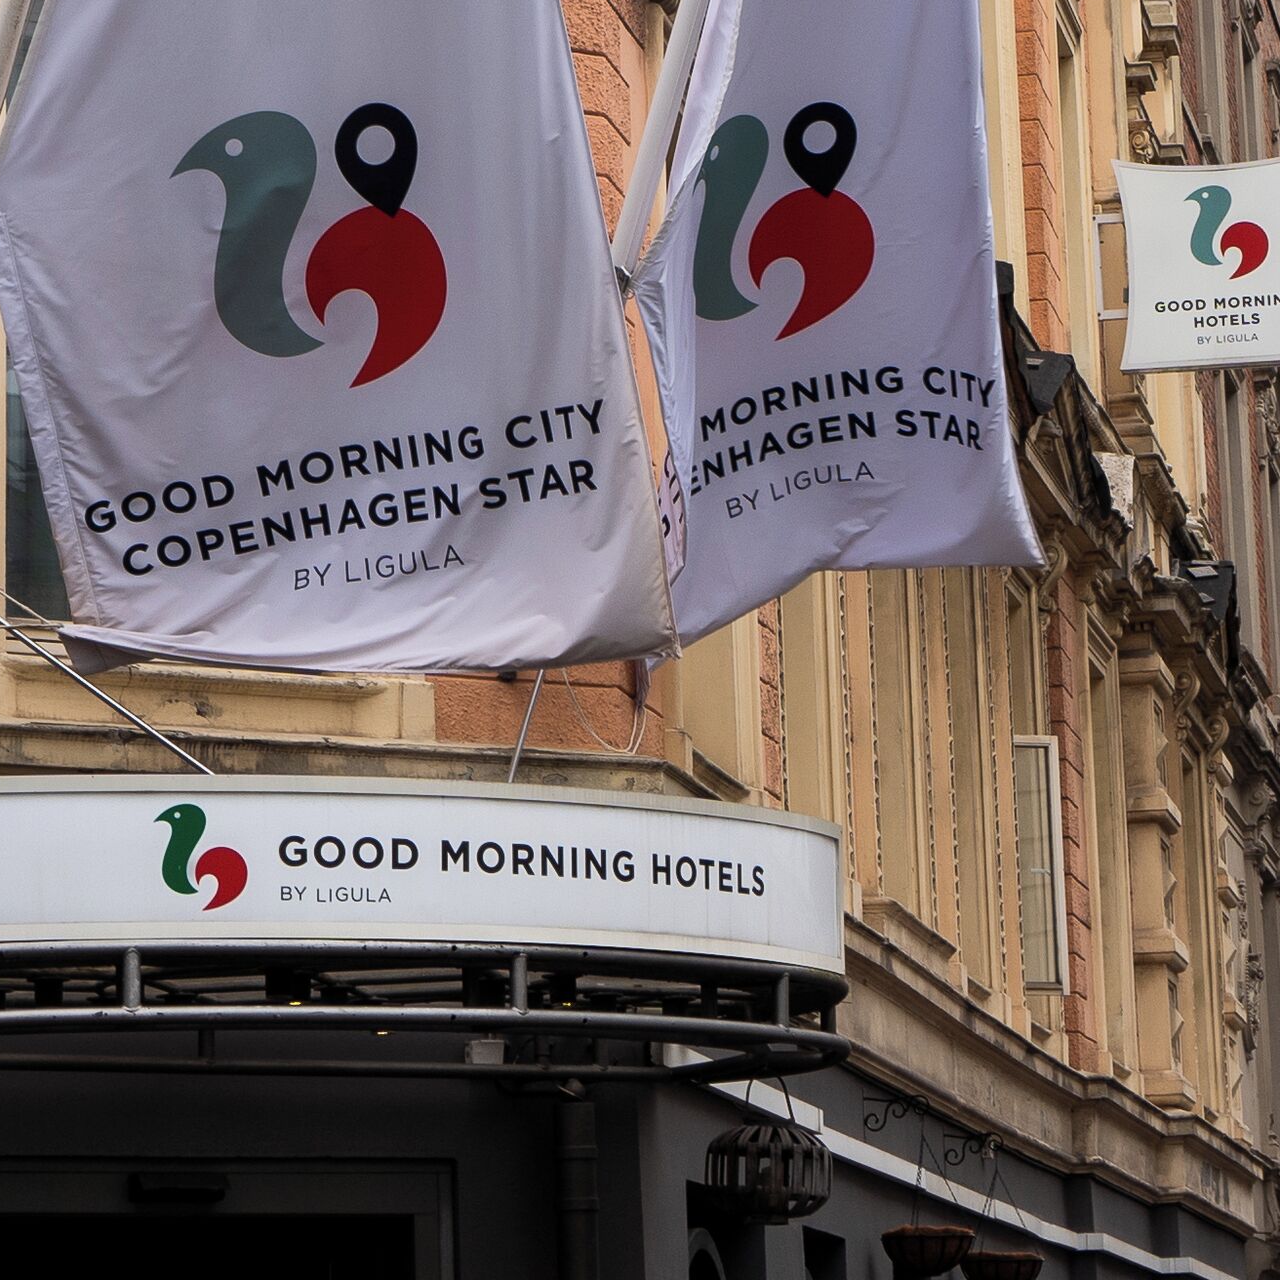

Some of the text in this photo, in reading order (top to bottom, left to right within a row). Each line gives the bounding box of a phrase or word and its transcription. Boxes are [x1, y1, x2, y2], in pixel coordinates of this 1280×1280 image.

[1154, 298, 1207, 313] GOOD
[1193, 312, 1261, 329] HOTELS
[1196, 332, 1259, 345] BY LIGULA
[700, 366, 996, 443] MORNING CITY
[895, 409, 984, 451] STAR
[84, 398, 604, 534] GOOD MORNING CITY
[725, 488, 759, 519] BY
[769, 461, 875, 502] LIGULA
[122, 483, 462, 576] COPENHAGEN
[478, 459, 598, 510] STAR
[294, 544, 465, 591] BY LIGULA
[278, 835, 765, 897] GOOD MORNING HOTELS
[280, 885, 392, 903] BY LIGULA
